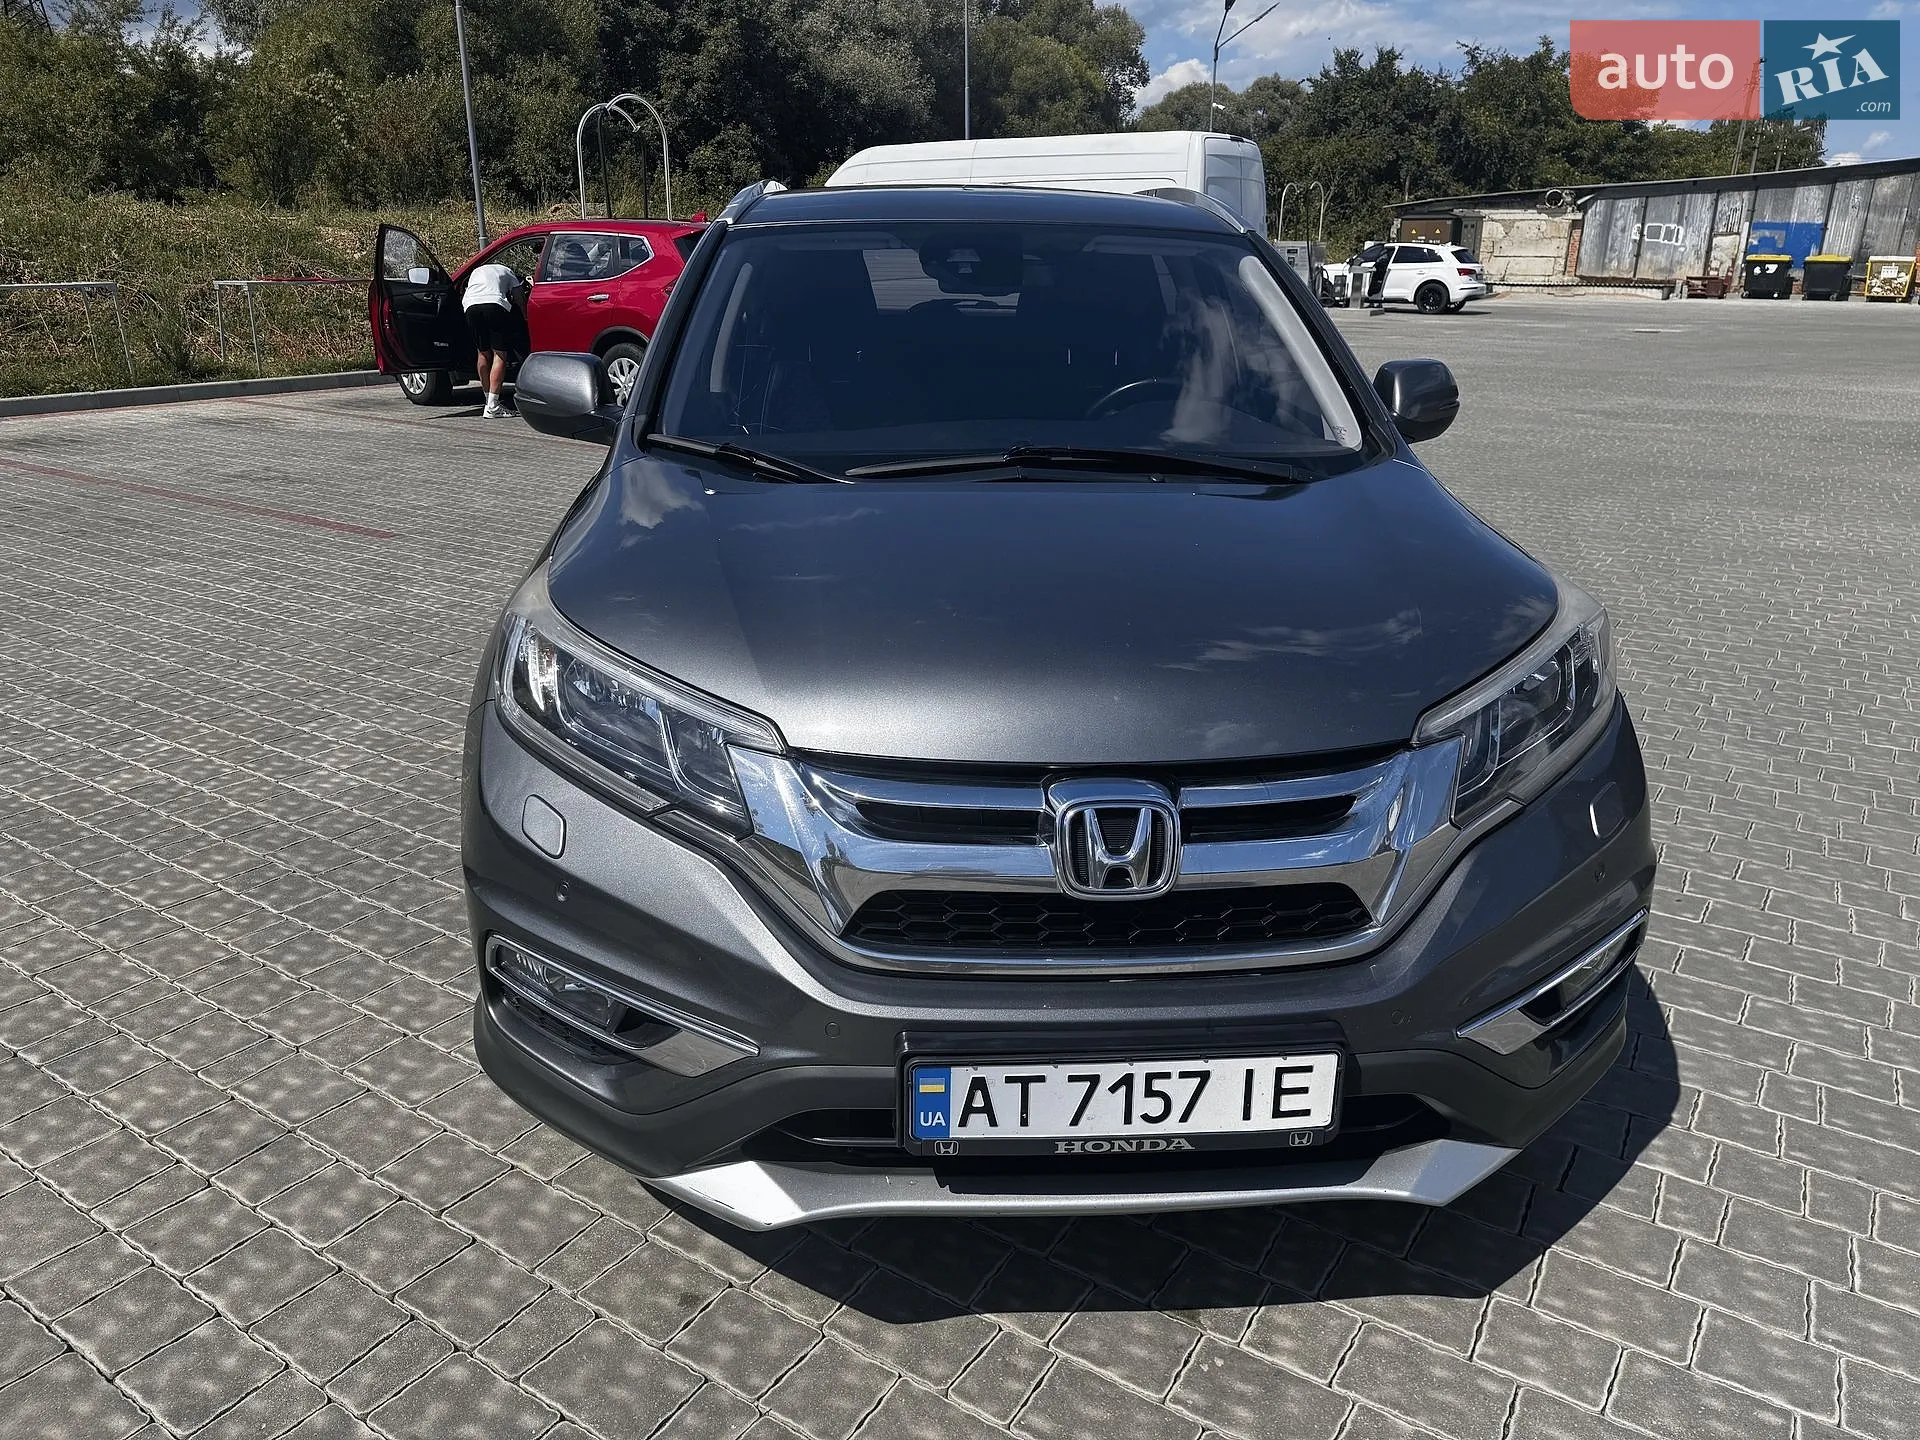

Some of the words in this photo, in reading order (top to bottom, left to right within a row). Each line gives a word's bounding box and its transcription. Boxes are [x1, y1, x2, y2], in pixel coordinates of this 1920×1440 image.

[957, 1074, 1047, 1128] AT
[1066, 1069, 1211, 1127] 7157
[1242, 1064, 1314, 1121] IE
[920, 1111, 946, 1127] UA
[1054, 1138, 1196, 1154] HONDA
